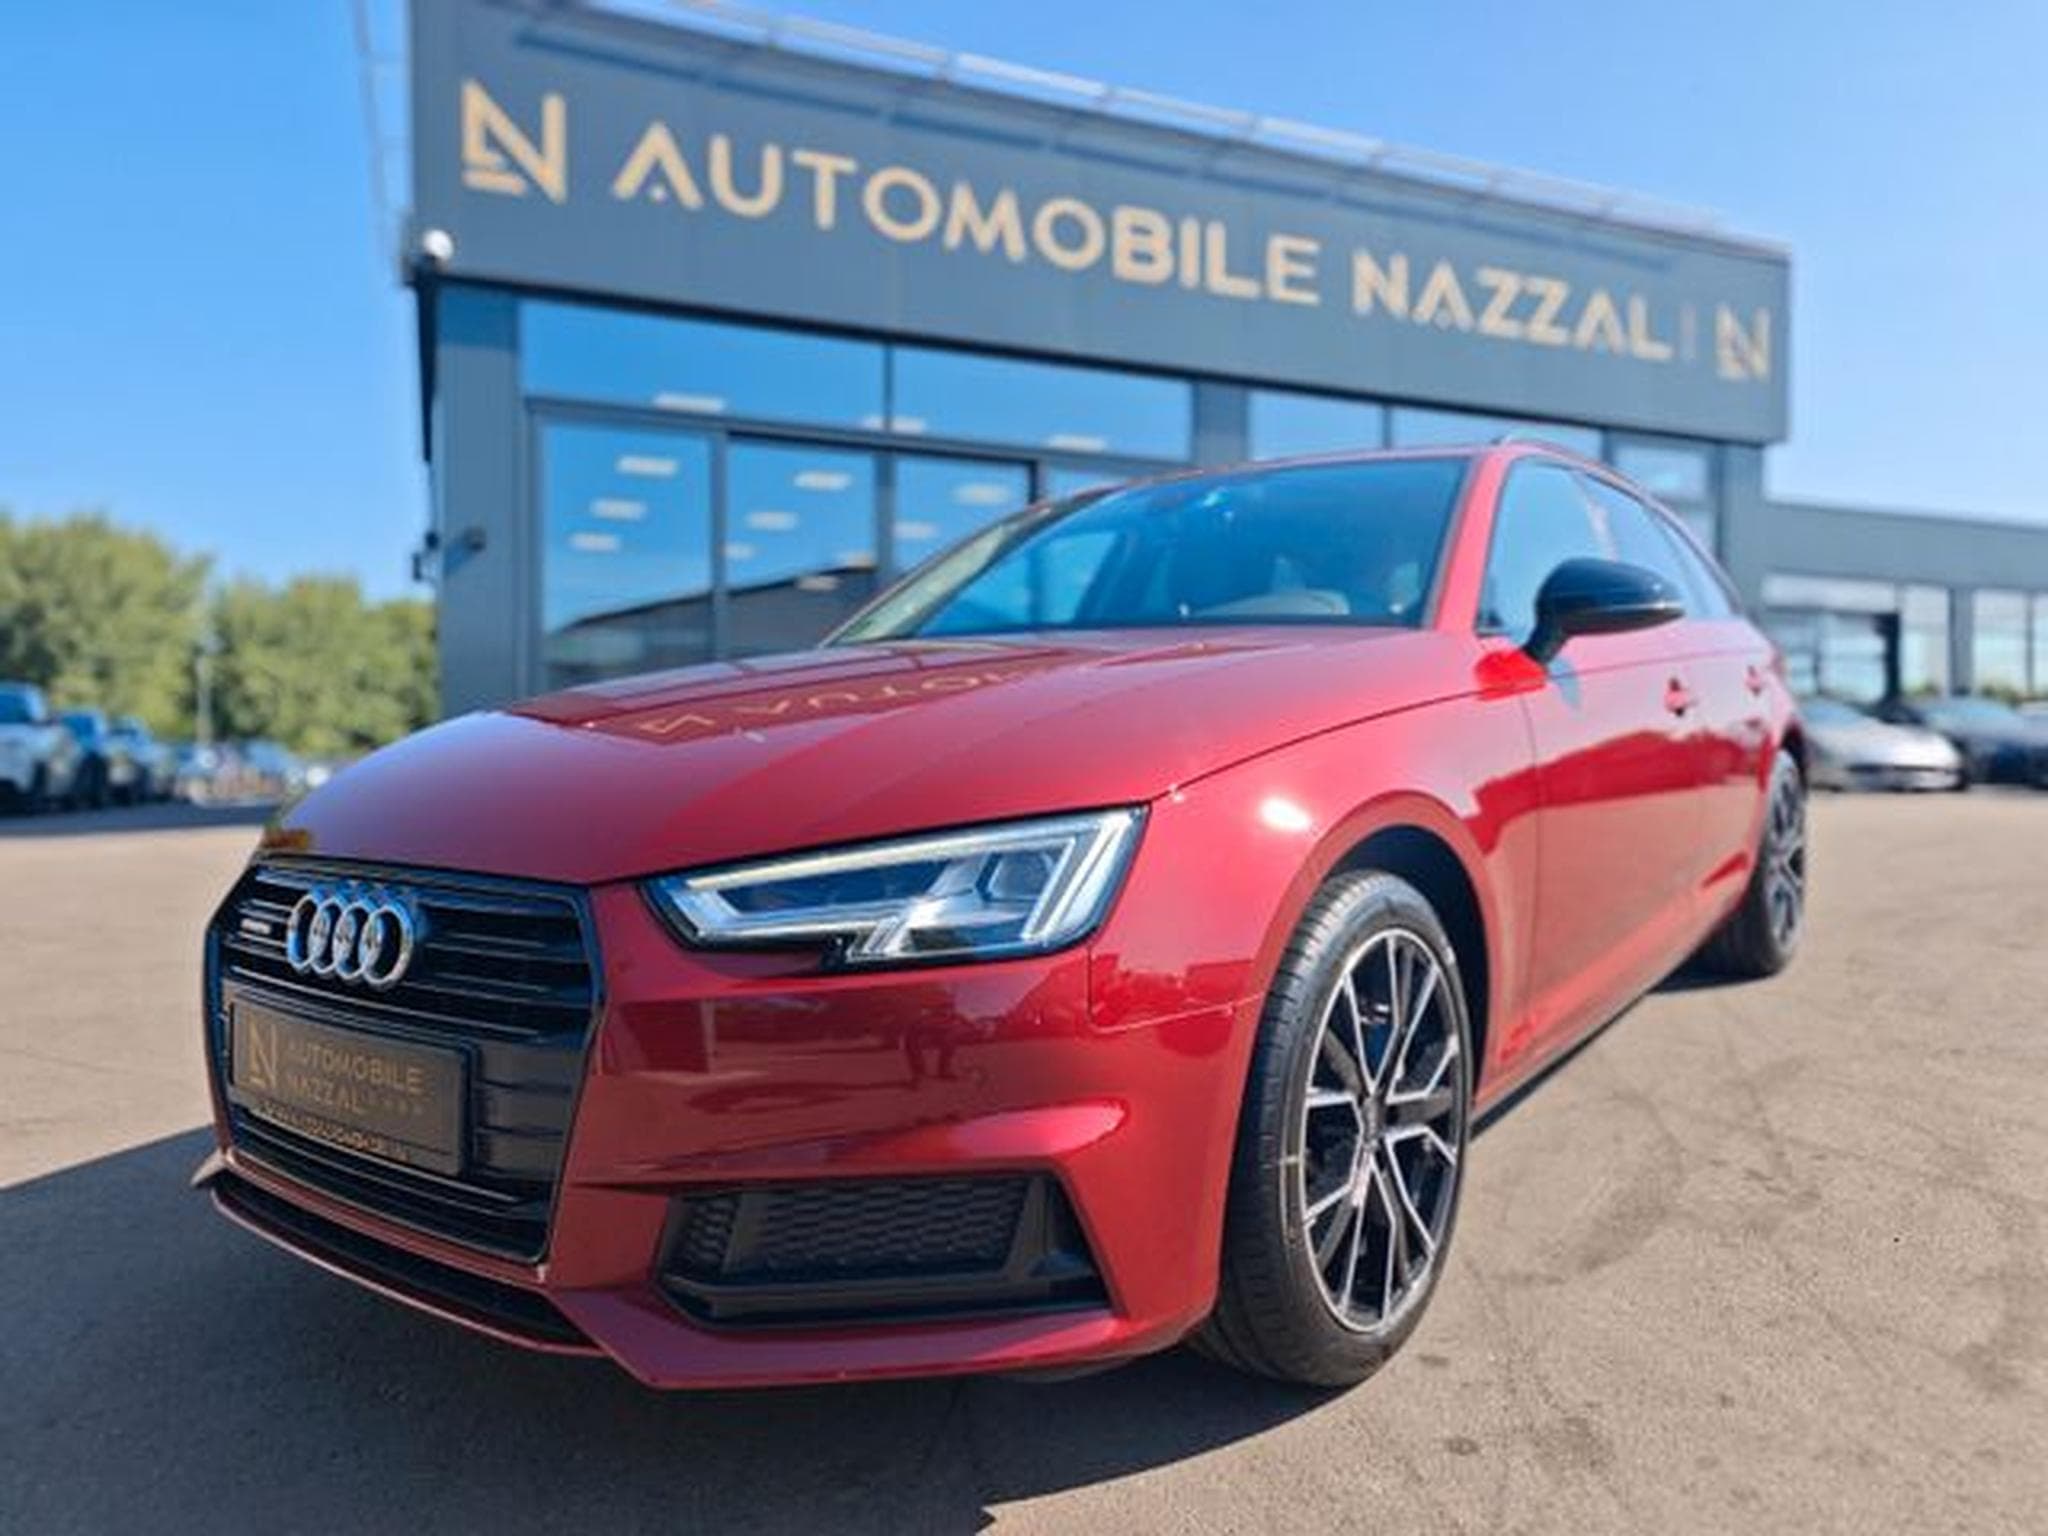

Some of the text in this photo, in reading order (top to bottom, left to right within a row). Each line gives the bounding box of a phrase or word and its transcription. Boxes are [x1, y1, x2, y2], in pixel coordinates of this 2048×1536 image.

[612, 121, 1321, 307] AUTOMOBILE
[1352, 248, 1673, 361] NAZZAL
[286, 1036, 425, 1096] AUTOMOBILE
